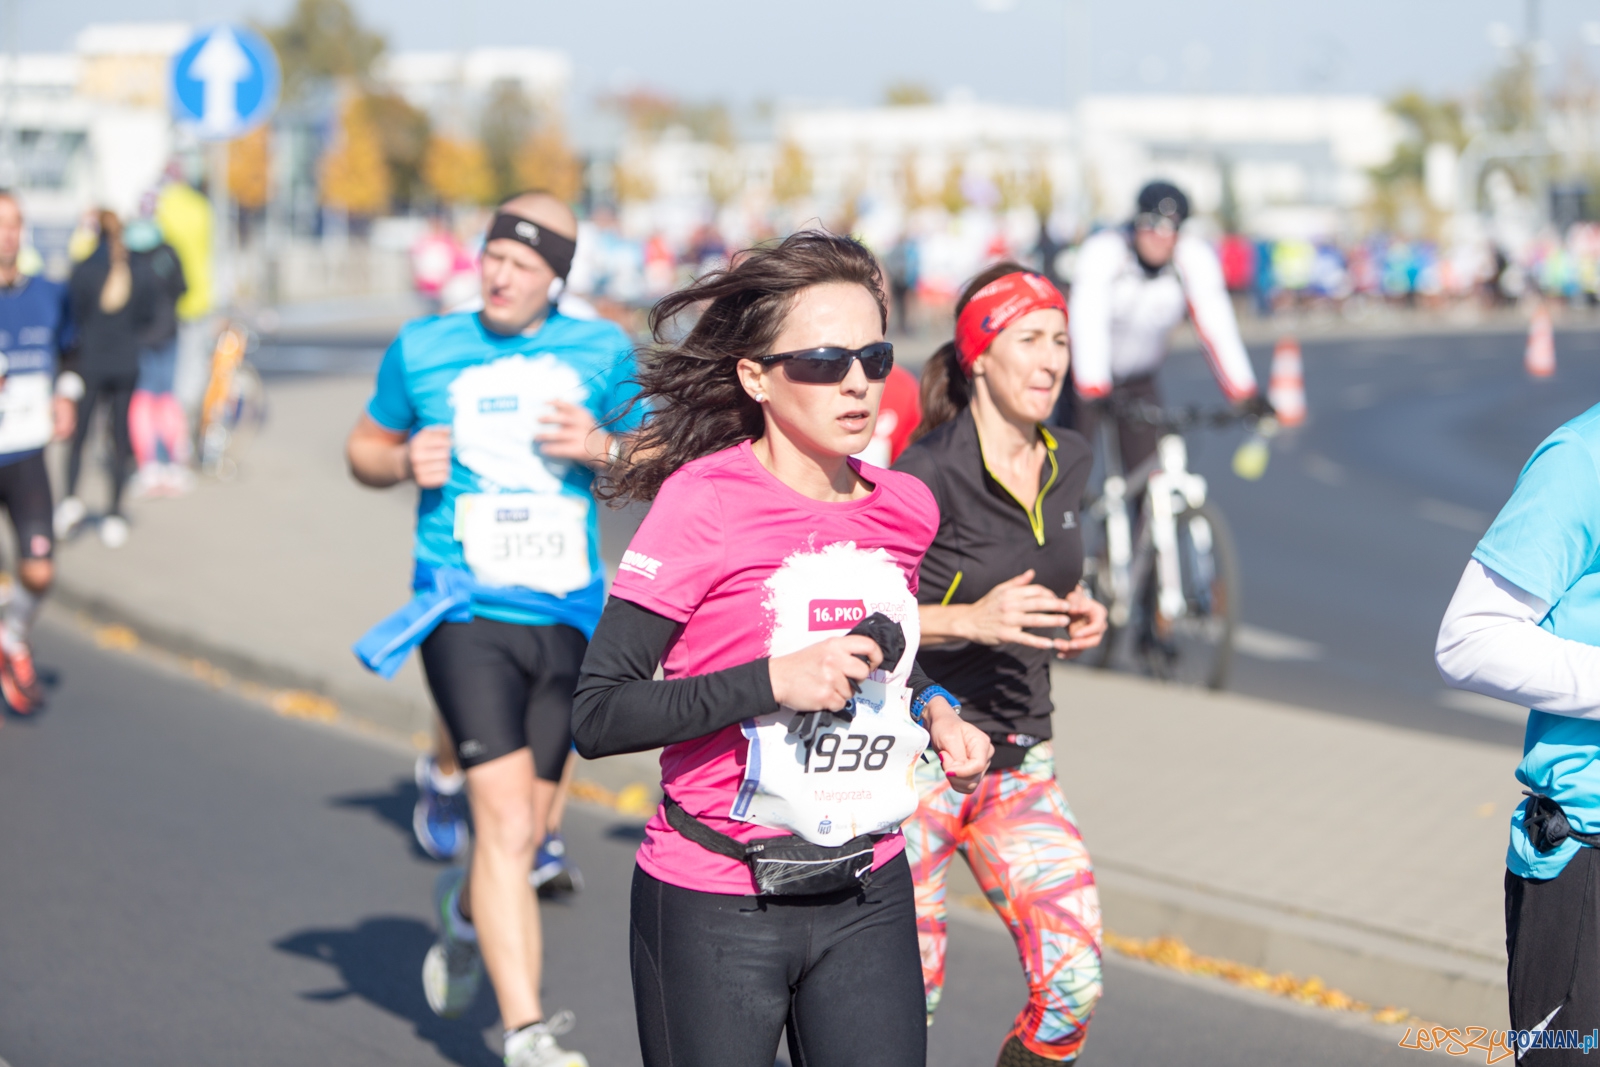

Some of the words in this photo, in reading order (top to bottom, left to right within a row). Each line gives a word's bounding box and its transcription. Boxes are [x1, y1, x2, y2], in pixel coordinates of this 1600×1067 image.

[493, 533, 565, 560] 3159
[813, 607, 834, 622] 16.
[834, 607, 864, 621] PKO
[804, 733, 896, 773] 1938
[814, 789, 872, 803] Małgorzata
